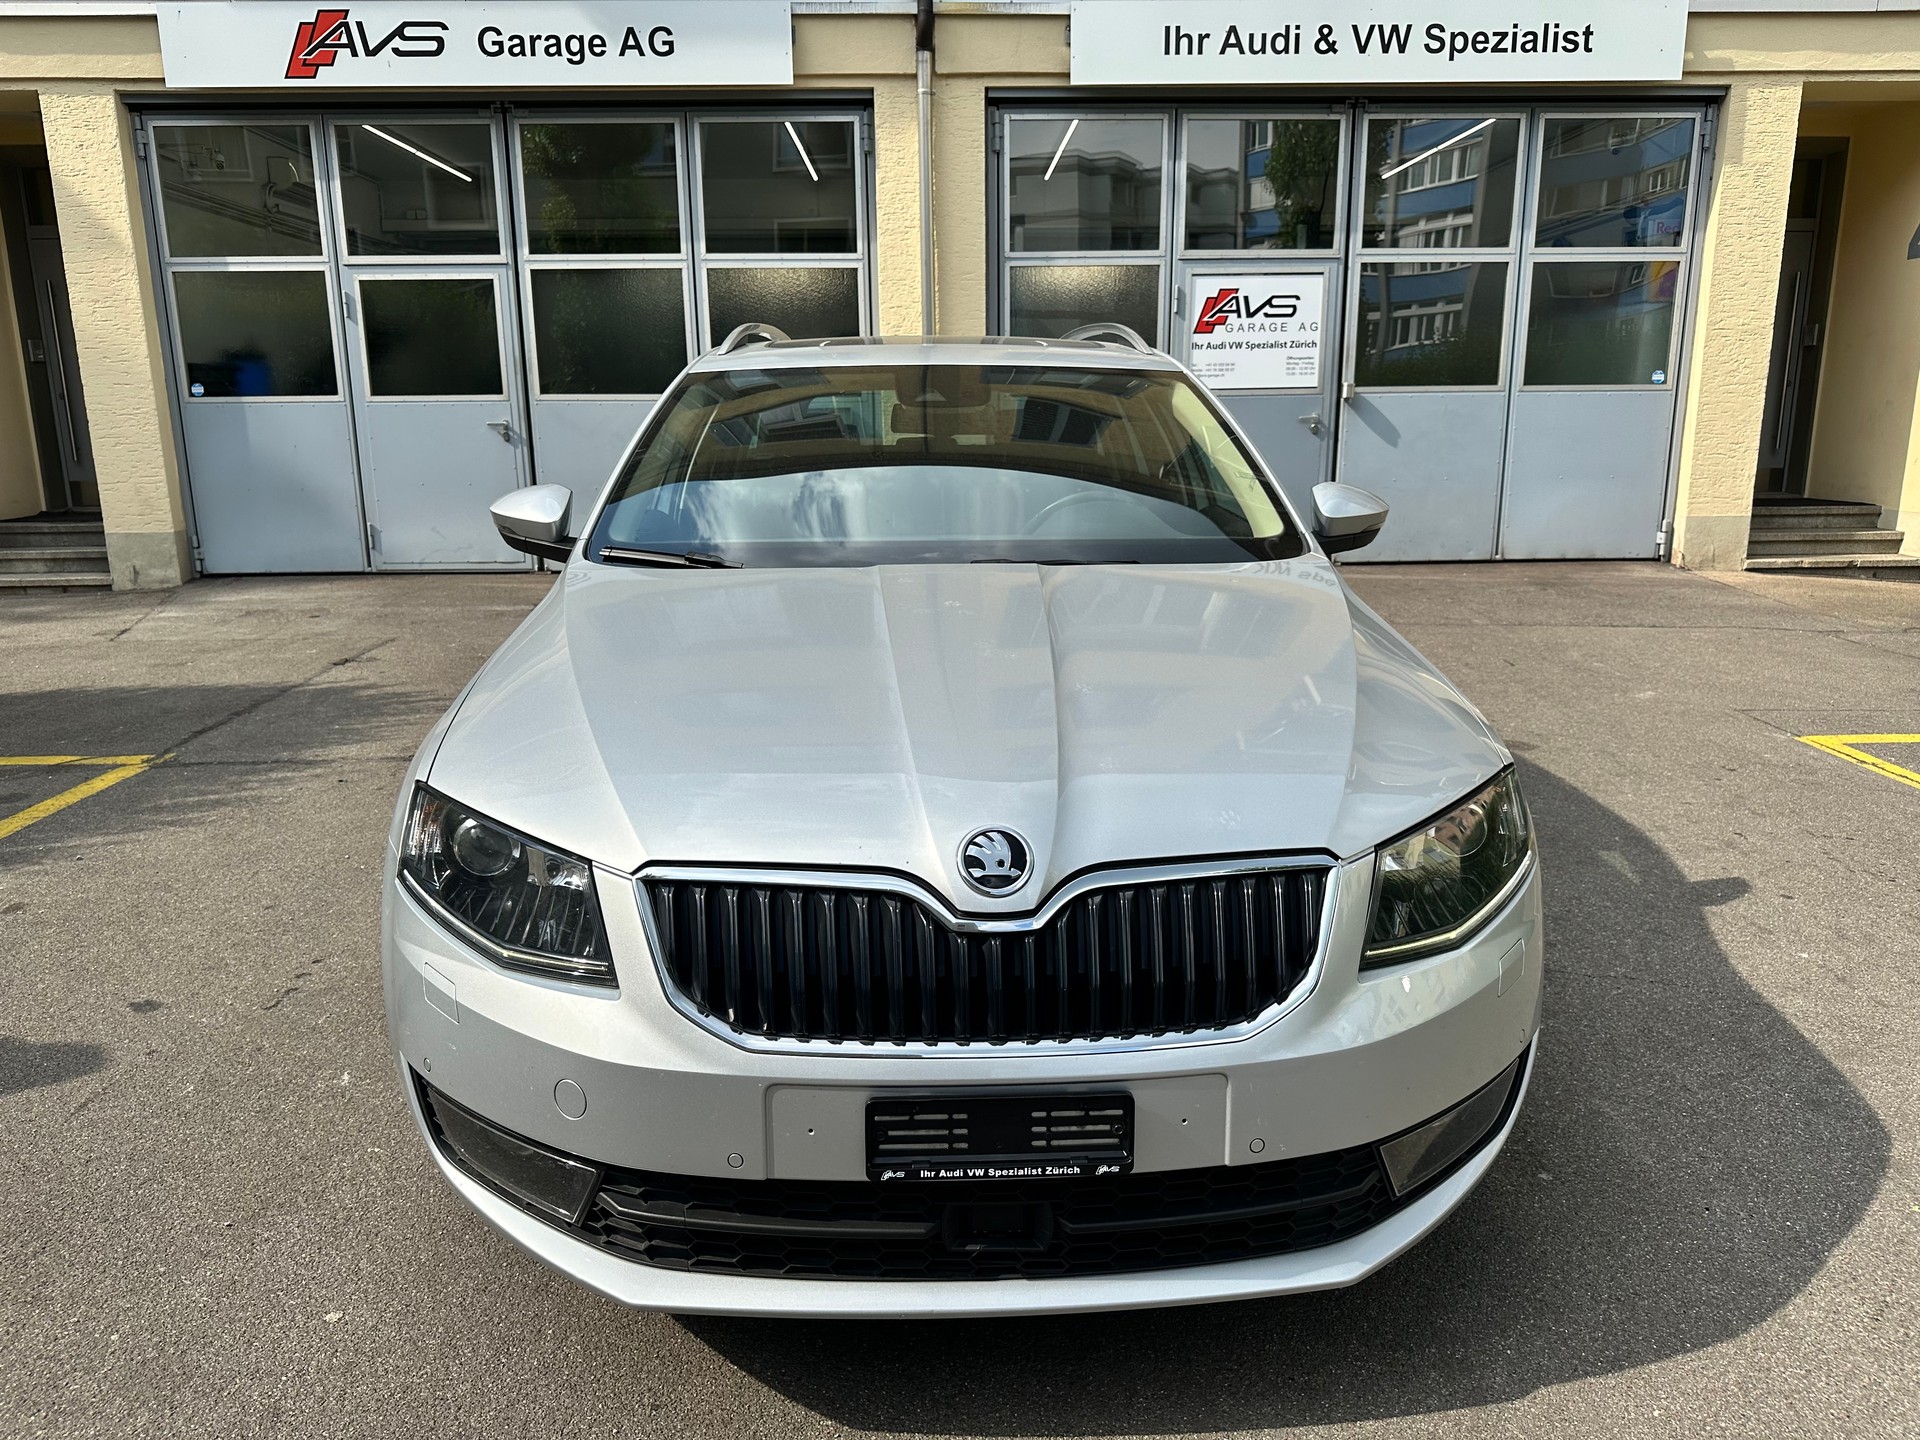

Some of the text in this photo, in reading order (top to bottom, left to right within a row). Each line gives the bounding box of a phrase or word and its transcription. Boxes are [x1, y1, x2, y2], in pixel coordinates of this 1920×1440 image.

[303, 20, 675, 65] AVS Garage AG
[1163, 23, 1594, 61] Ihr Audi & VW Spezialist
[1206, 294, 1300, 318] AVS
[1225, 322, 1319, 333] GARAGE AG
[1191, 340, 1317, 351] Ihr Audi VW Spezialist Zürich
[939, 1169, 963, 1177] Audi
[967, 1168, 985, 1176] VW
[988, 1167, 1042, 1177] Spezialist
[1045, 1166, 1080, 1175] Zürich
